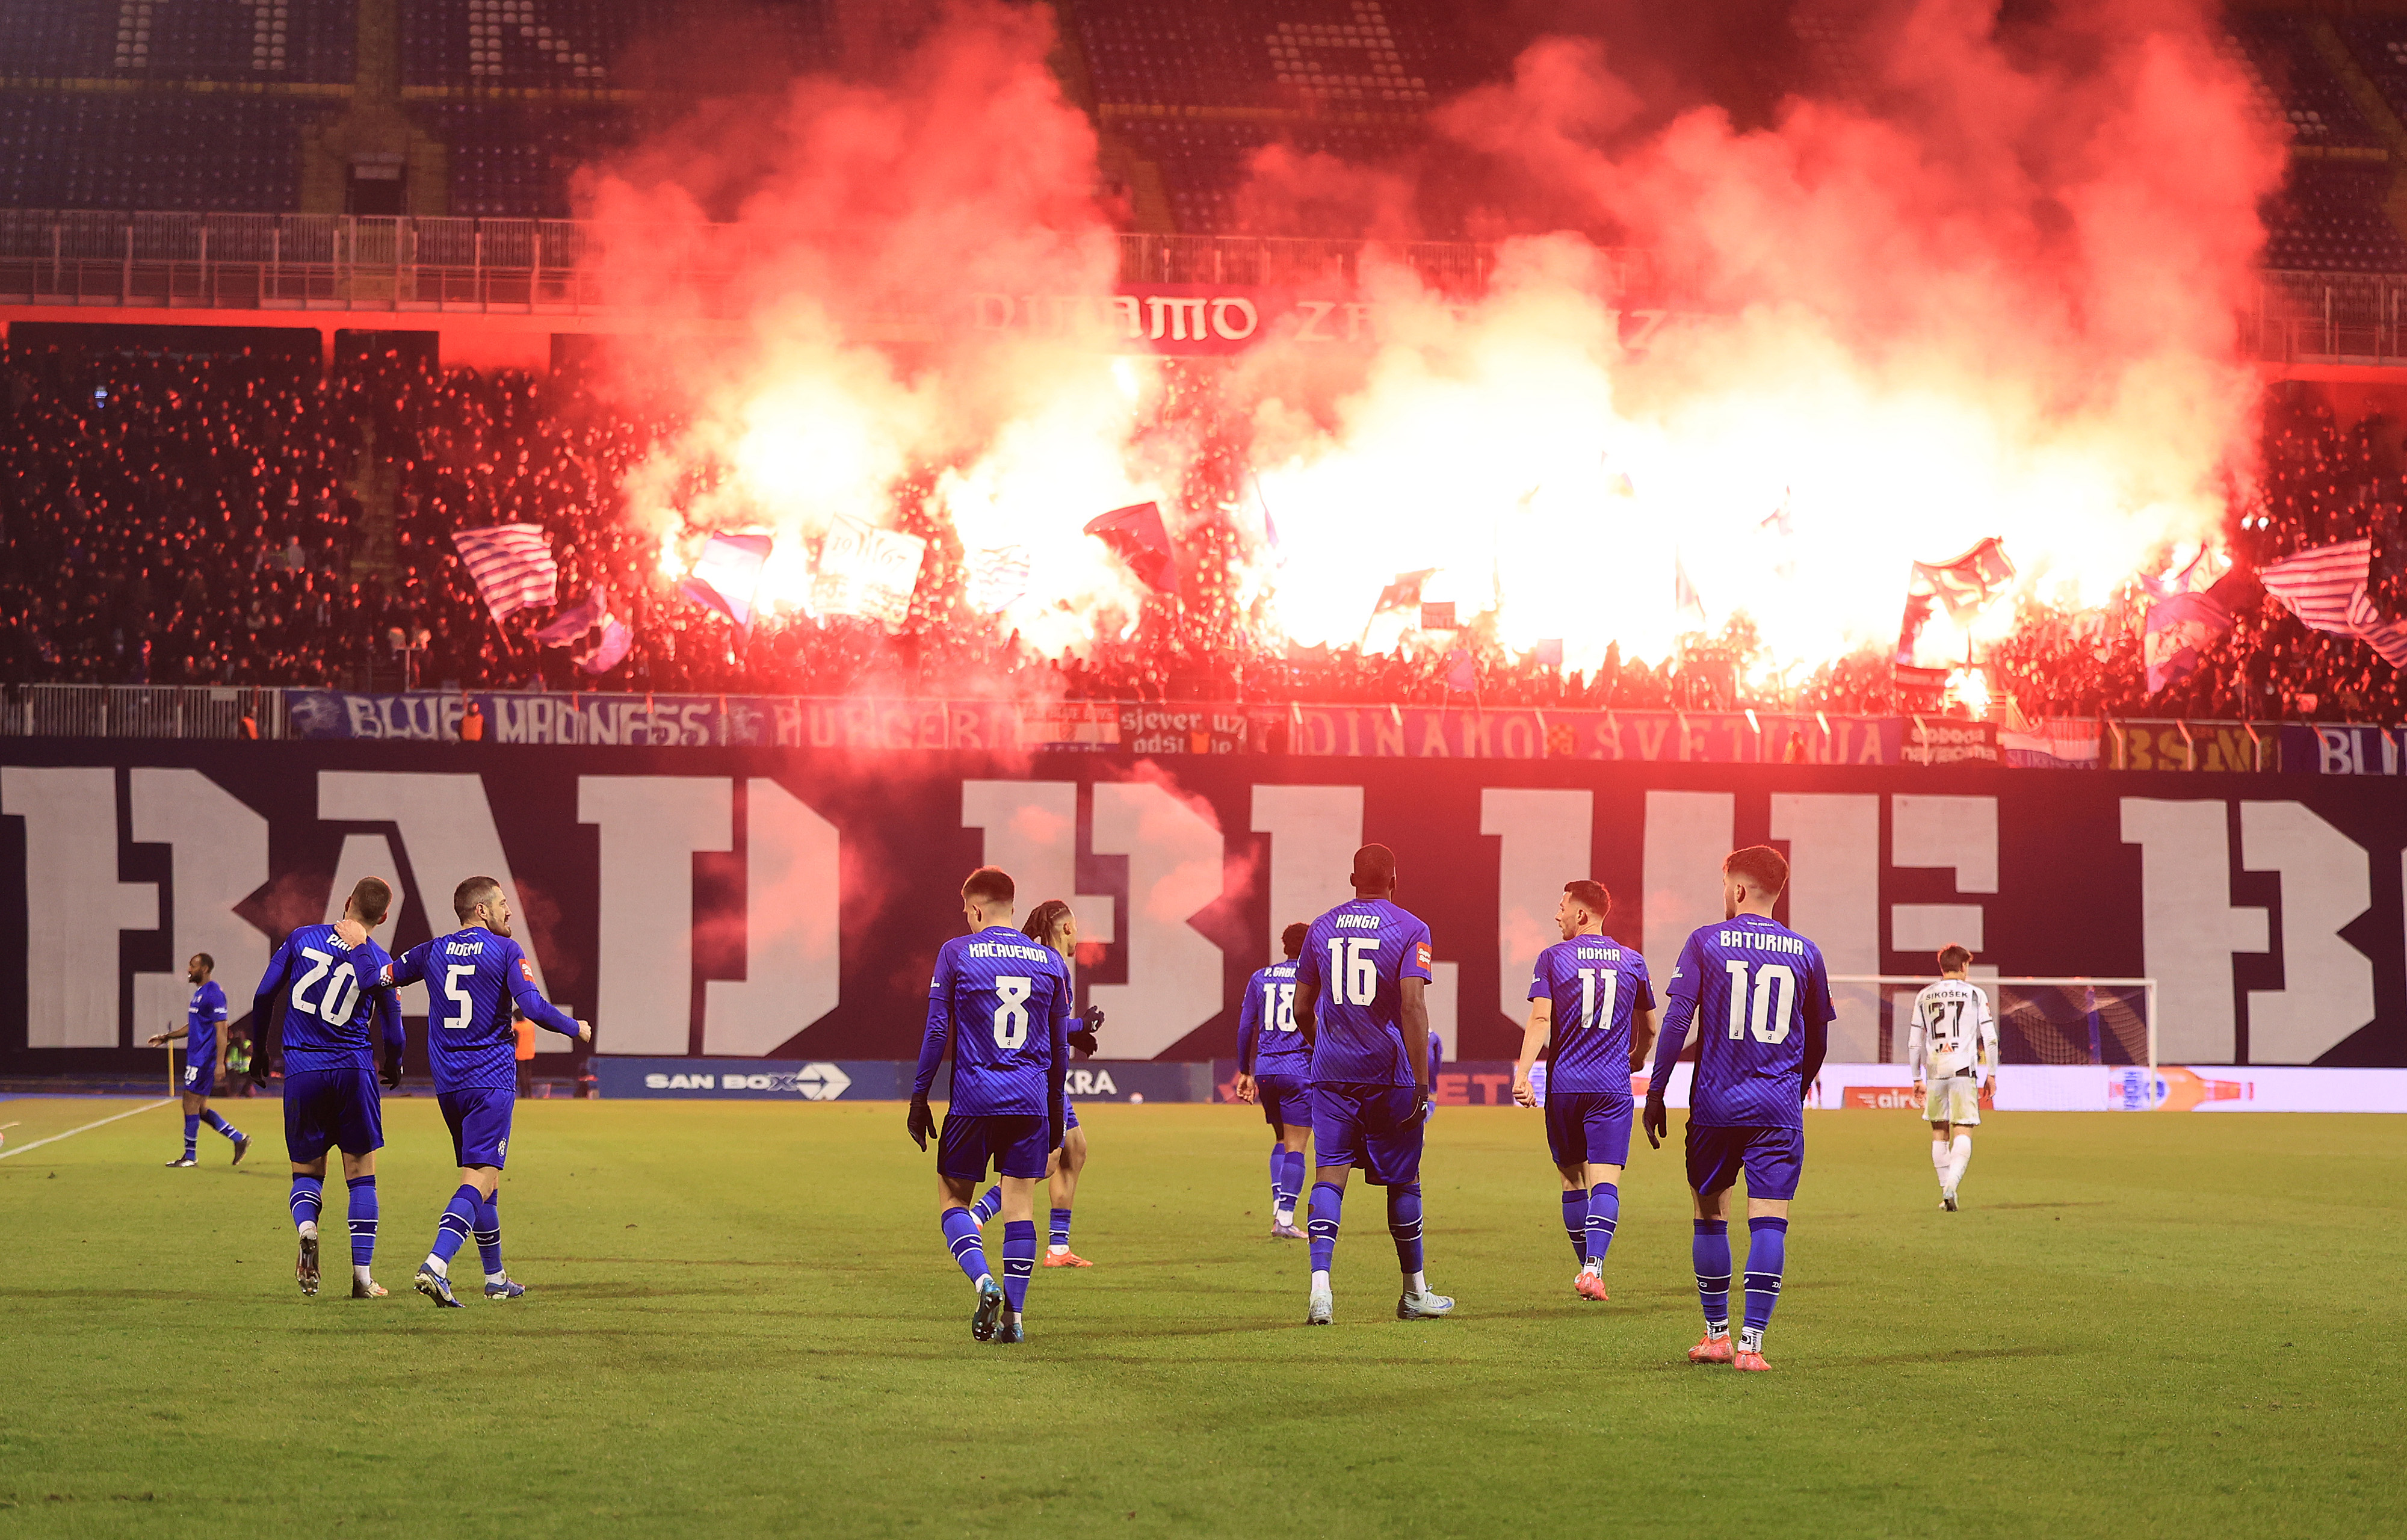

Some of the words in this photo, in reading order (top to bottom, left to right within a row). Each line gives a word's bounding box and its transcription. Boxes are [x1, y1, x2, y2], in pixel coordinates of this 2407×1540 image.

[494, 697, 712, 744] MADNESS
[1120, 707, 1203, 735] sjever
[1304, 712, 1534, 759] DINAMO
[1, 765, 840, 1058] BAD
[961, 780, 2000, 1065] BLUE
[1335, 914, 1381, 930] KANGA
[445, 942, 484, 957] ADEMI
[968, 940, 1049, 965] KAČAVENDA
[1577, 947, 1621, 962] HOXHA
[1719, 930, 1804, 956] BATURINA
[292, 946, 361, 1027] 20
[1327, 936, 1381, 1007] 16
[1926, 990, 1968, 1000] SIKOŠEK
[443, 964, 476, 1029] 5
[993, 975, 1032, 1050] 8
[1263, 983, 1298, 1032] 18
[1577, 968, 1618, 1030] 11
[1725, 959, 1796, 1045] 10
[1928, 1001, 1965, 1041] 27
[644, 1074, 715, 1090] SAN
[721, 1072, 800, 1092] BOX
